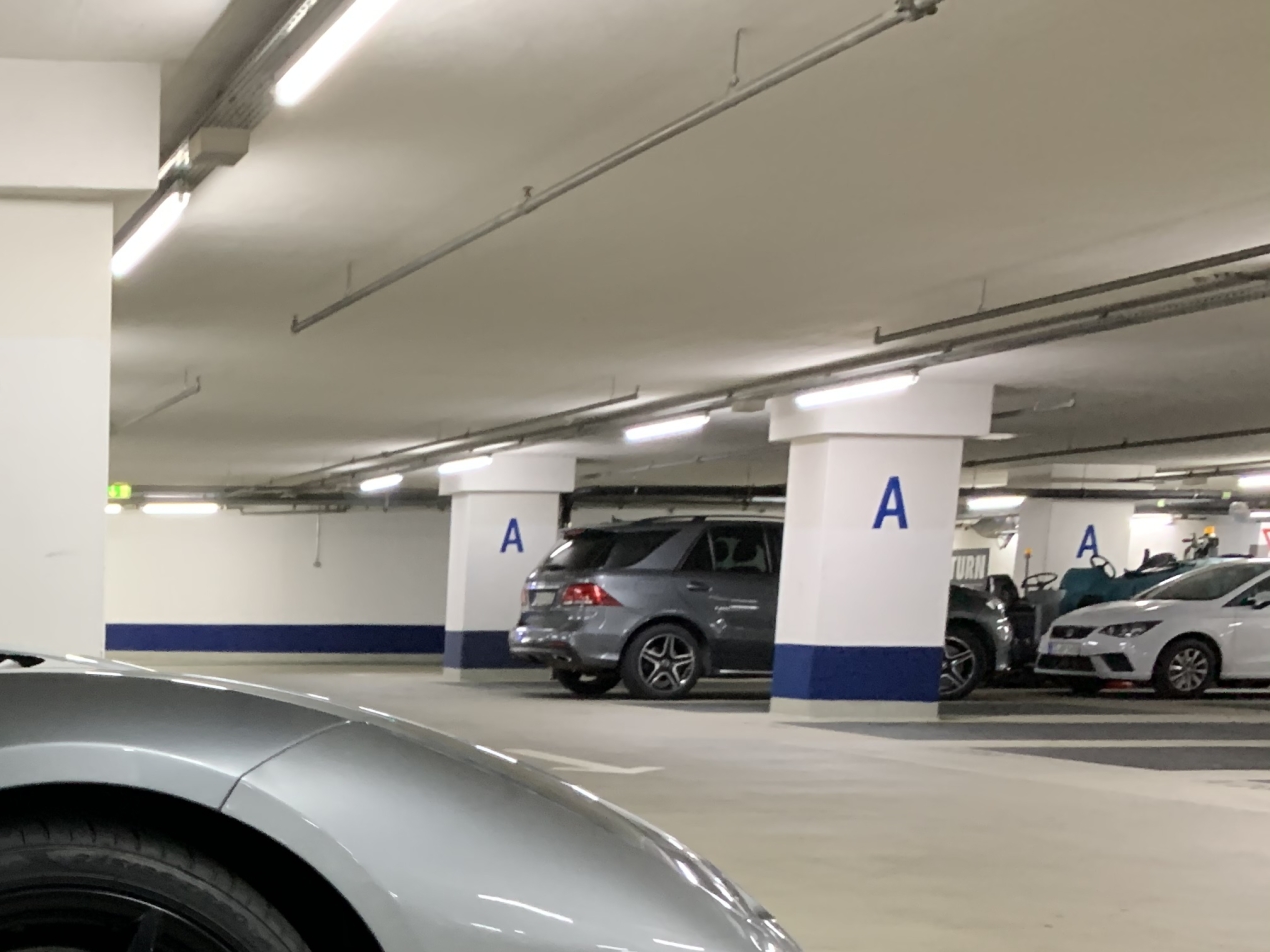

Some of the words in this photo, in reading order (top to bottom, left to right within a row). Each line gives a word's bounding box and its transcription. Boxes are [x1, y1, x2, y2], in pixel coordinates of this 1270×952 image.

[873, 476, 908, 529] A
[500, 517, 523, 552] A
[1076, 524, 1100, 559] A
